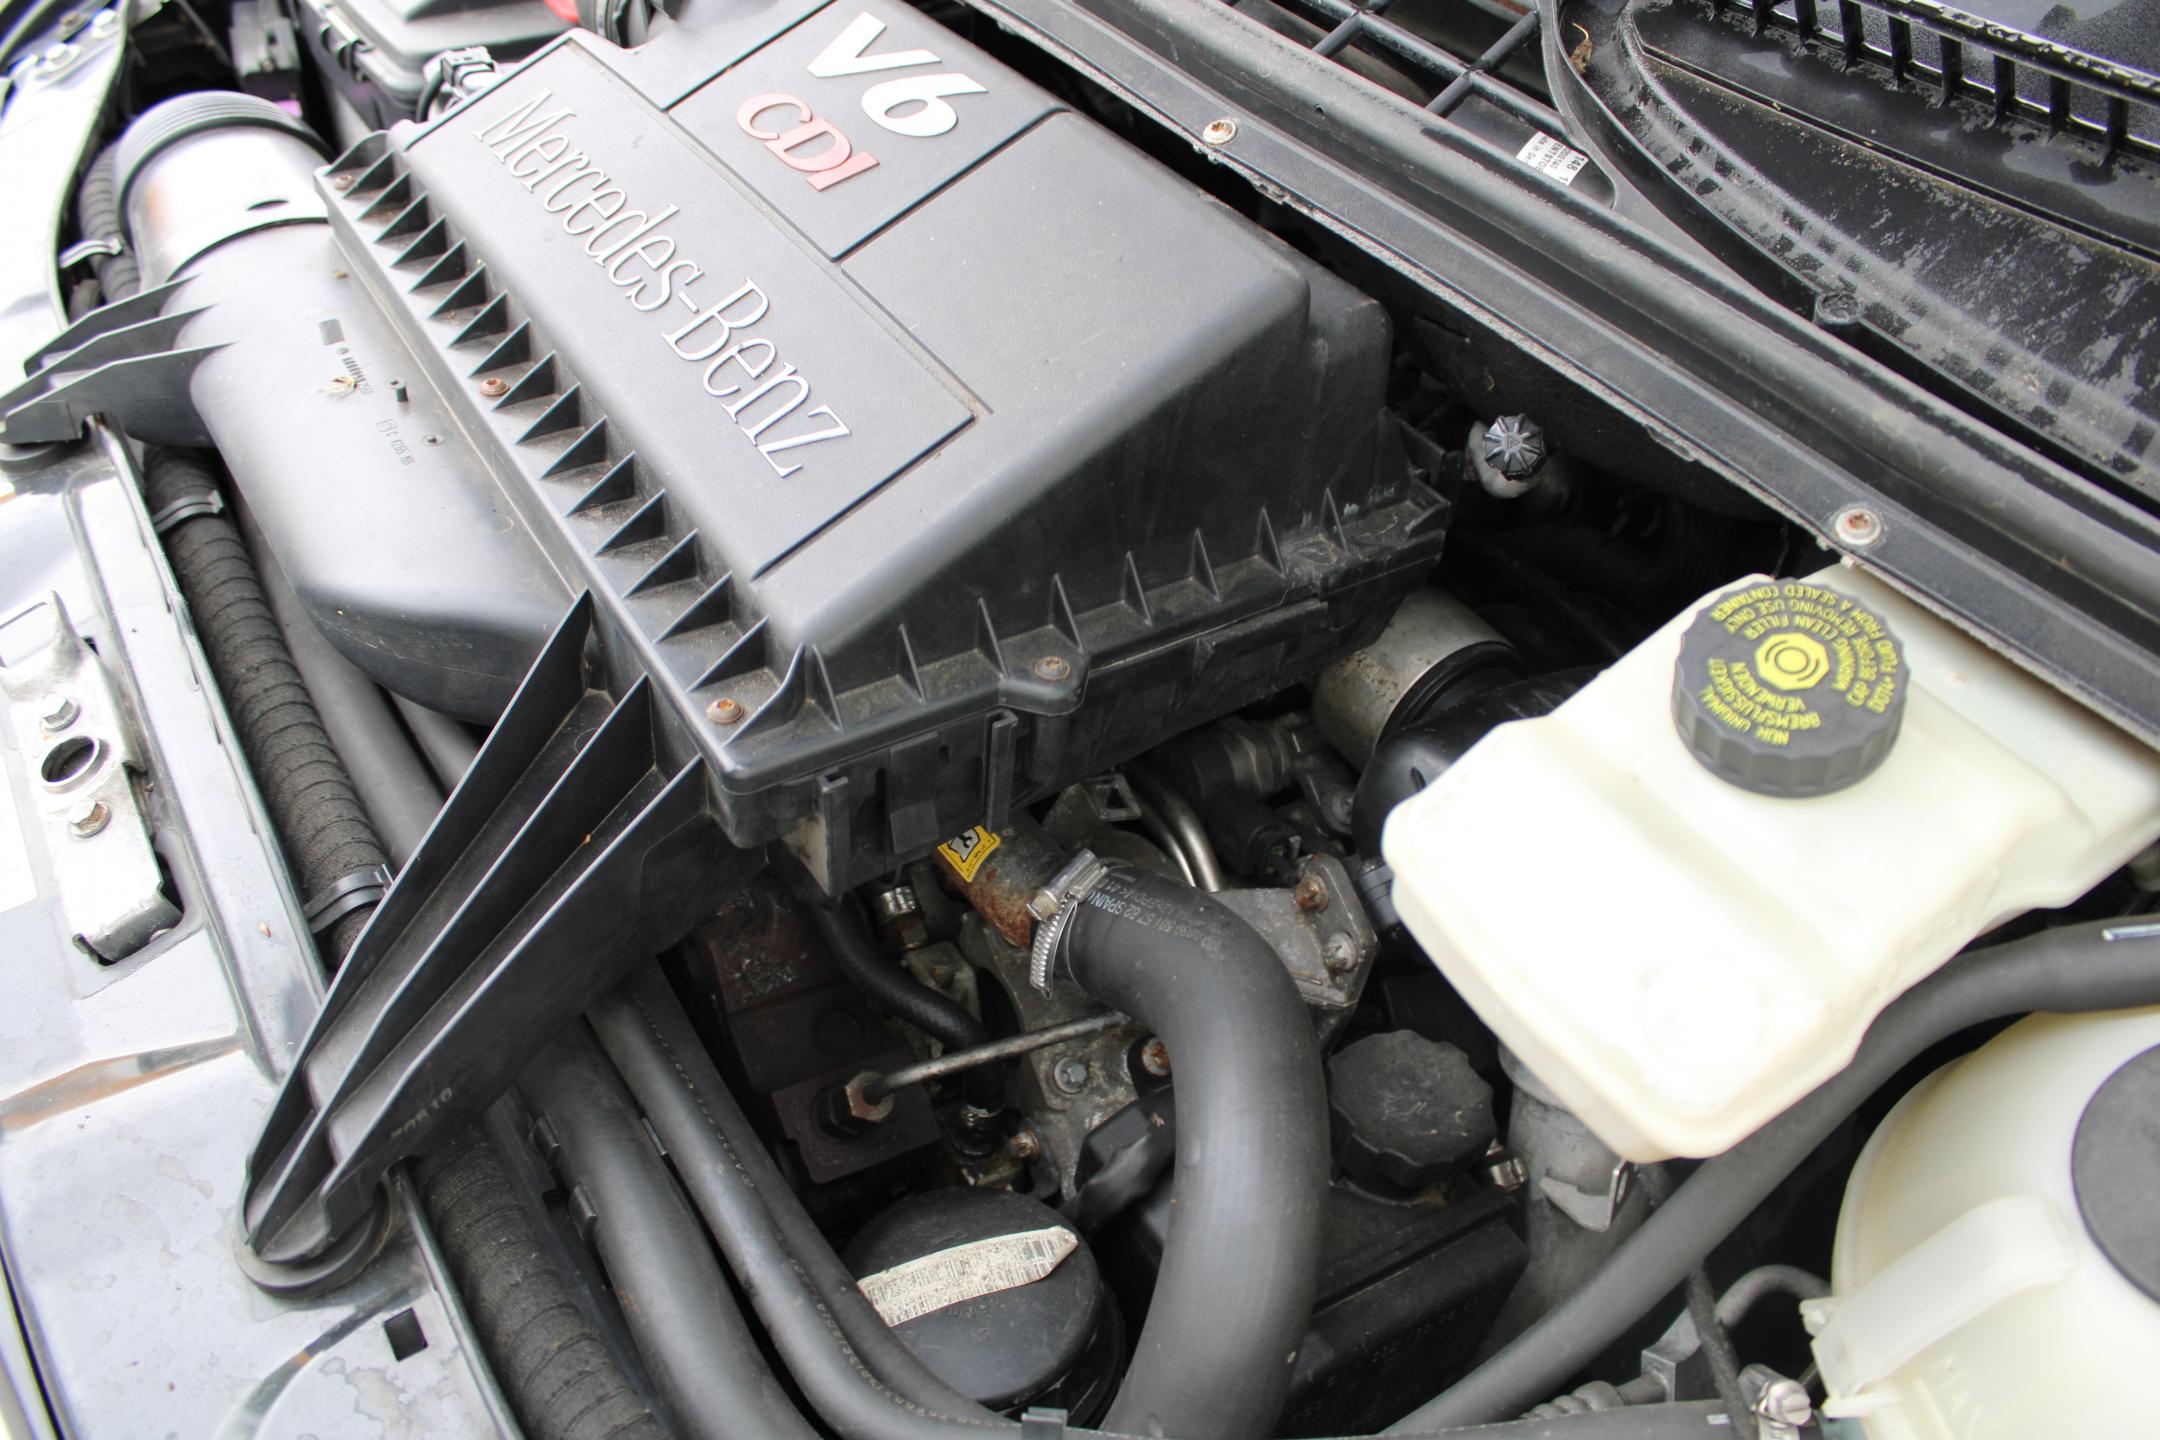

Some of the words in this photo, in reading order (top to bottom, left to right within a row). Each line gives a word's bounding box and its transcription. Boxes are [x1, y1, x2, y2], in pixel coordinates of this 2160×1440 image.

[806, 10, 990, 137] V6
[736, 92, 881, 193] CDI
[472, 86, 853, 479] Mercedes-Benz
[1710, 585, 1779, 622] CONTAINER
[1756, 600, 1785, 615] USE
[1784, 584, 1839, 605] SEALED
[1840, 599, 1853, 612] A
[1724, 607, 1756, 635] ONLY
[1742, 614, 1789, 641] FILLER
[1789, 599, 1860, 637] REMOVING
[1793, 614, 1838, 640] CLEAN
[1851, 608, 1886, 640] FROM
[1852, 634, 1878, 682] BEFORE
